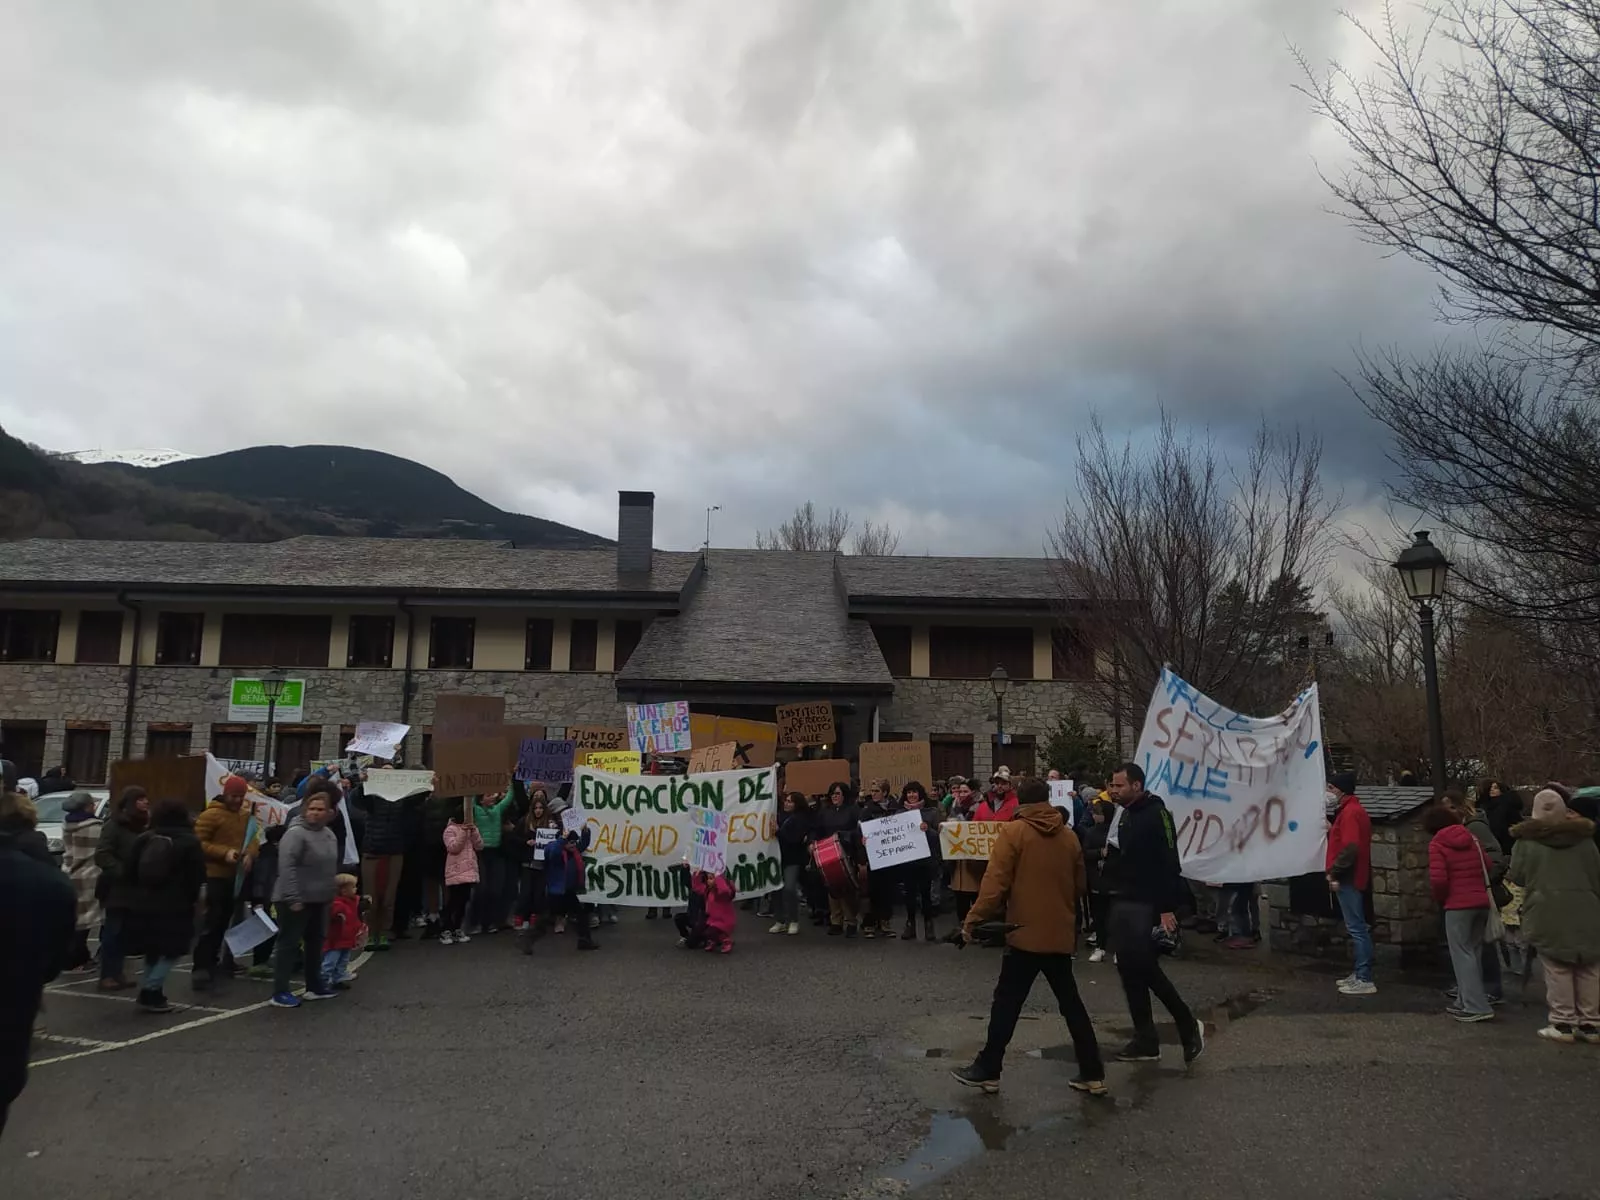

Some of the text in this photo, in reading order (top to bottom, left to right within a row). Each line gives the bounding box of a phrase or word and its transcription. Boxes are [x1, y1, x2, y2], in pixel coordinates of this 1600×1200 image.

[629, 702, 687, 721] JUNTOS
[574, 730, 628, 742] JUNTOS
[629, 716, 690, 737] HACEMOS
[637, 732, 686, 753] VALLE
[738, 771, 773, 804] DE
[1143, 752, 1231, 803] VALLE
[583, 818, 678, 857] CALIDAD
[966, 837, 996, 856] SEP
